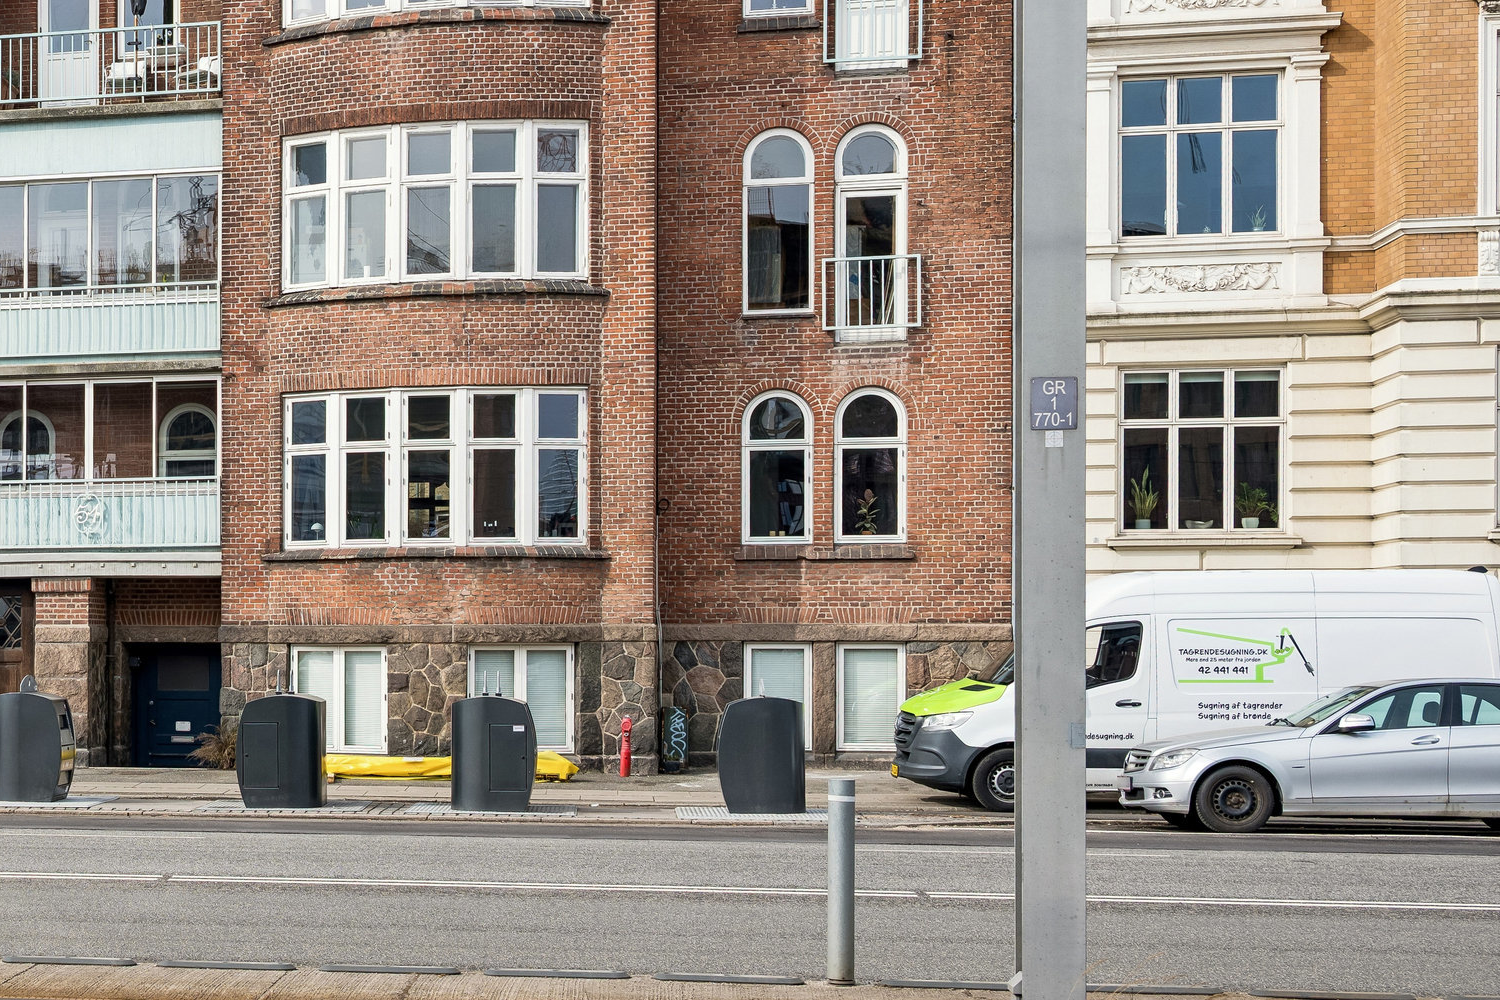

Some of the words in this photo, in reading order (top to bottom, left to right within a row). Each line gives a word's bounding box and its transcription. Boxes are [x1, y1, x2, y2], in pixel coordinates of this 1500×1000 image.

[1042, 380, 1066, 395] GR
[1050, 396, 1057, 410] 1
[1034, 412, 1073, 427] 770-1
[1178, 648, 1268, 656] TAGRENDESUGNING.DK
[1198, 666, 1211, 674] 42
[1213, 666, 1230, 674] 441
[1232, 666, 1249, 674] 441
[1198, 702, 1230, 711] Sugning
[1231, 702, 1240, 710] af
[1243, 702, 1283, 711] tagrender
[1198, 712, 1230, 722] Sugning
[1231, 712, 1240, 720] af
[1243, 712, 1272, 720] brønde
